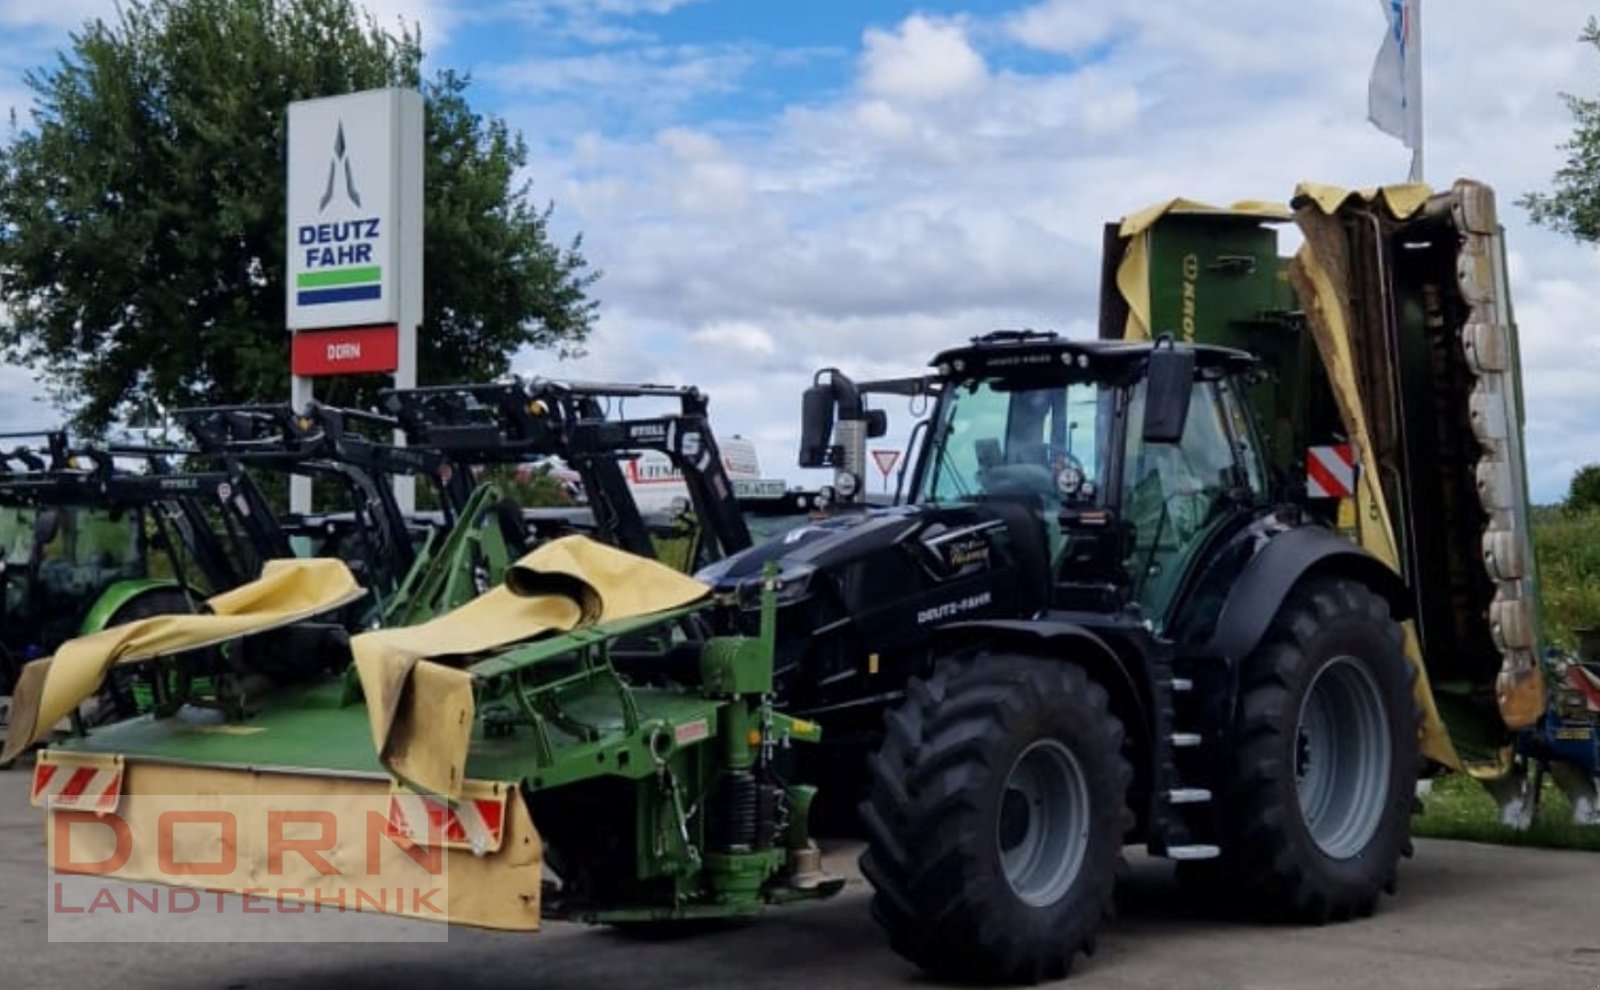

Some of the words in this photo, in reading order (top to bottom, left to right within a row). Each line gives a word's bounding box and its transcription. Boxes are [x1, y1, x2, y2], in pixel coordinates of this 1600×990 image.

[298, 218, 380, 245] DEUTZ
[305, 243, 372, 268] FAHR
[326, 342, 361, 360] DORN
